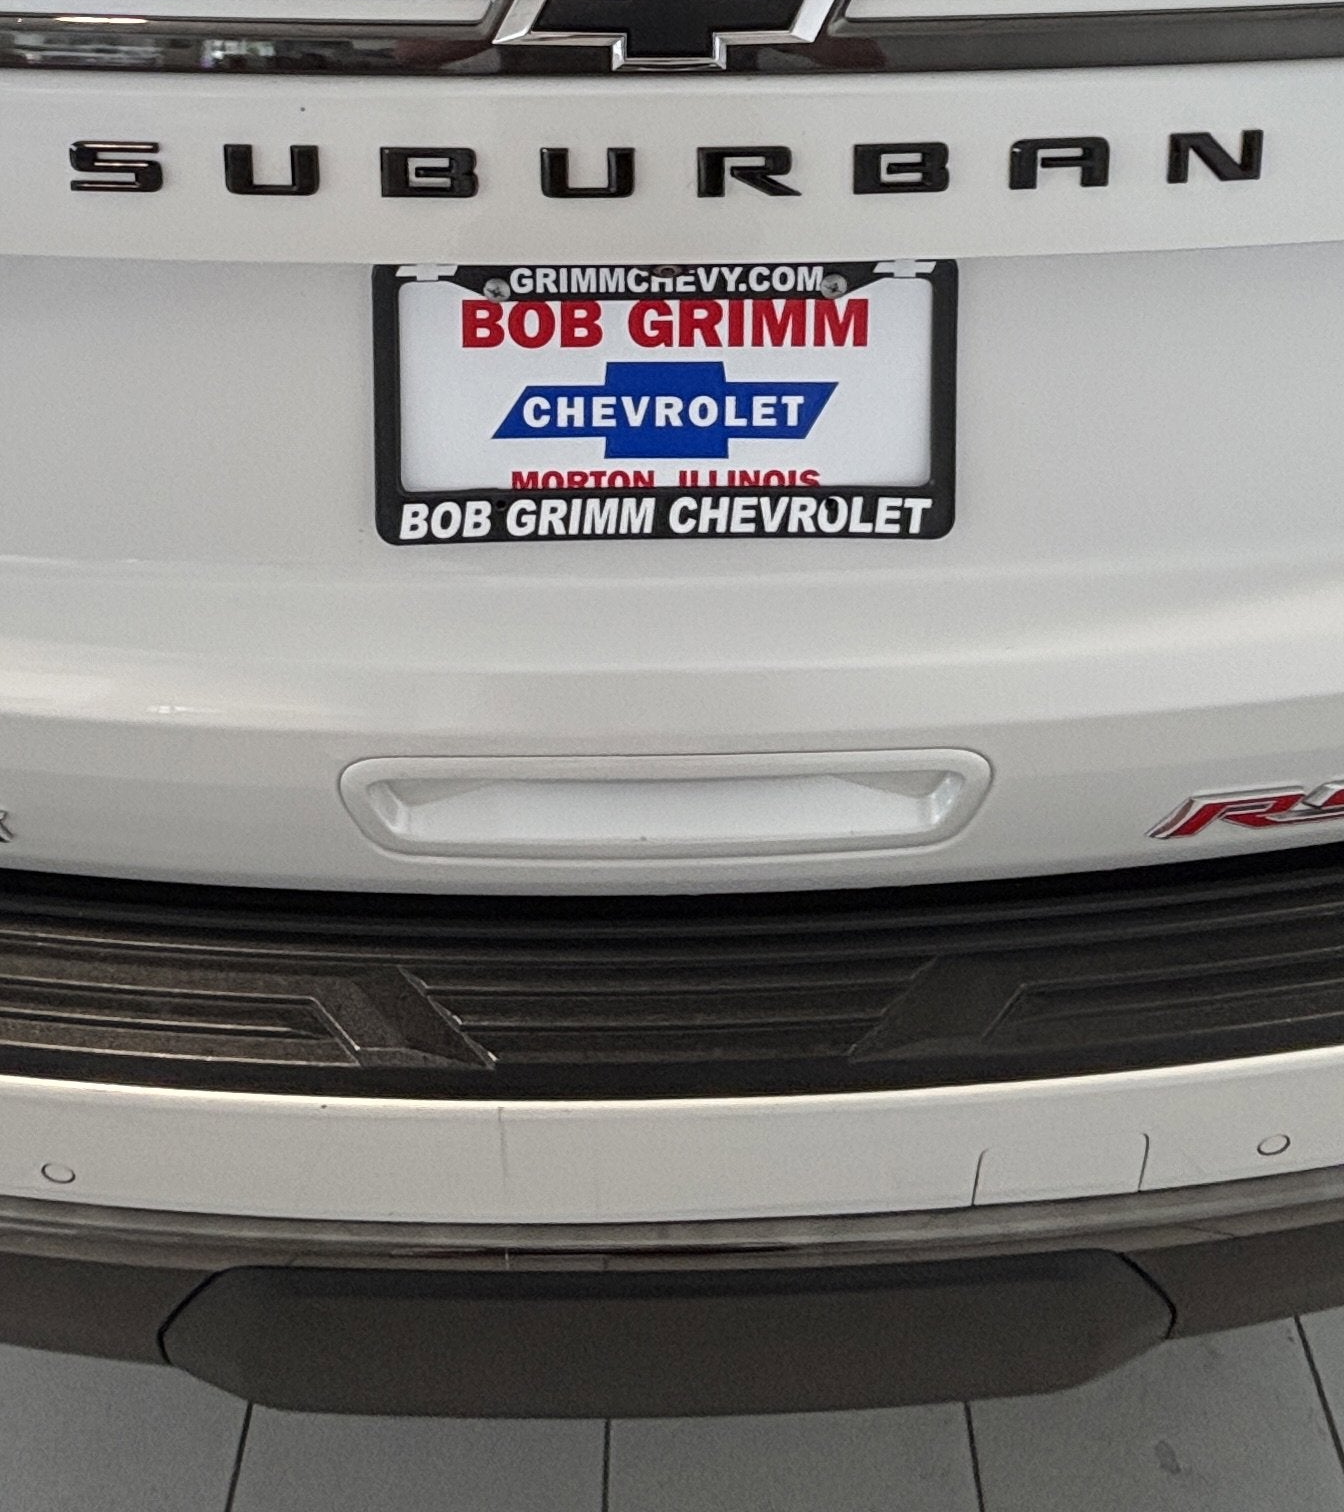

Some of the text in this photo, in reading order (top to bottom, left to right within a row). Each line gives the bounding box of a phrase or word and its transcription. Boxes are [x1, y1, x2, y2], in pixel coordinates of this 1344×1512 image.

[69, 129, 1264, 198] SUBURBAN
[509, 266, 824, 294] GRIMMCHEVY.COM
[462, 299, 868, 348] BOB GRIMM
[523, 395, 805, 427] CHEVROLET
[511, 470, 655, 490] MORTON
[399, 496, 932, 539] BOB GRIMM CHEVROLET
